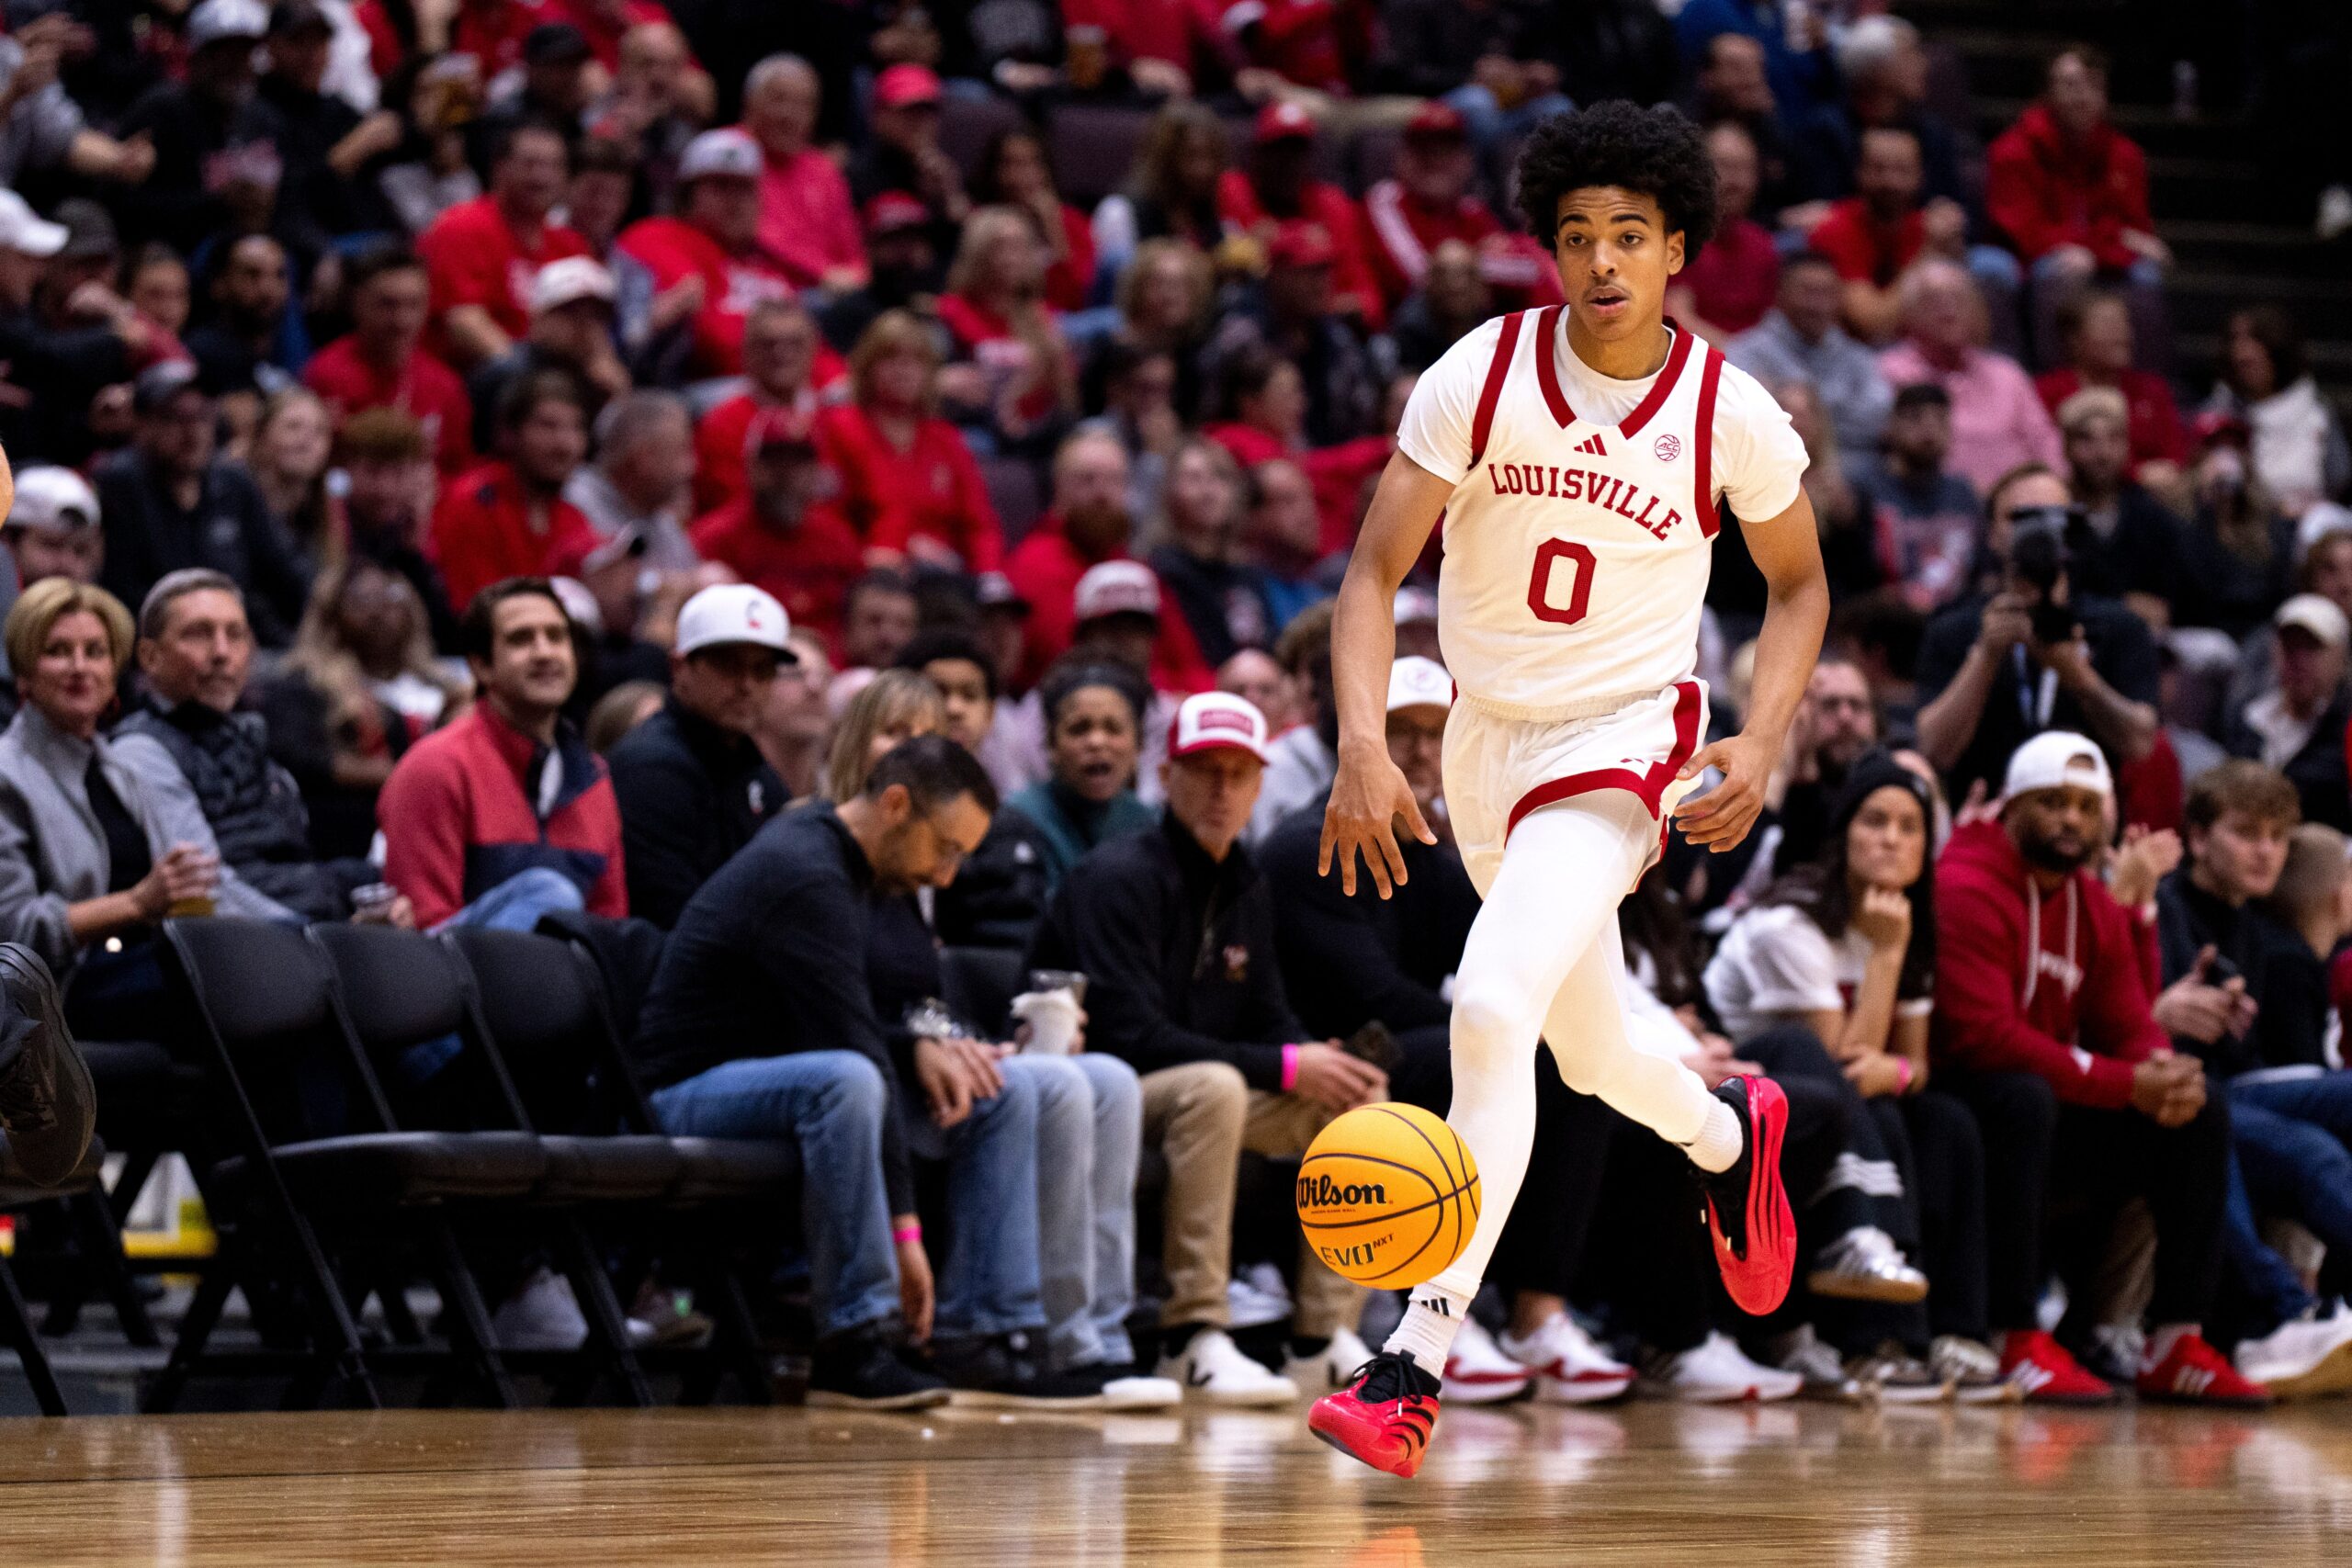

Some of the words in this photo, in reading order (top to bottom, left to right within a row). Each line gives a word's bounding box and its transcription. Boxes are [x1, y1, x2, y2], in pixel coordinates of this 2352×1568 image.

[1657, 442, 1680, 452] ACC
[1487, 463, 1683, 542] LOUISVILLE
[1526, 536, 1598, 626] 0
[1297, 1174, 1386, 1209] Wilson
[1373, 1234, 1394, 1248] NXT
